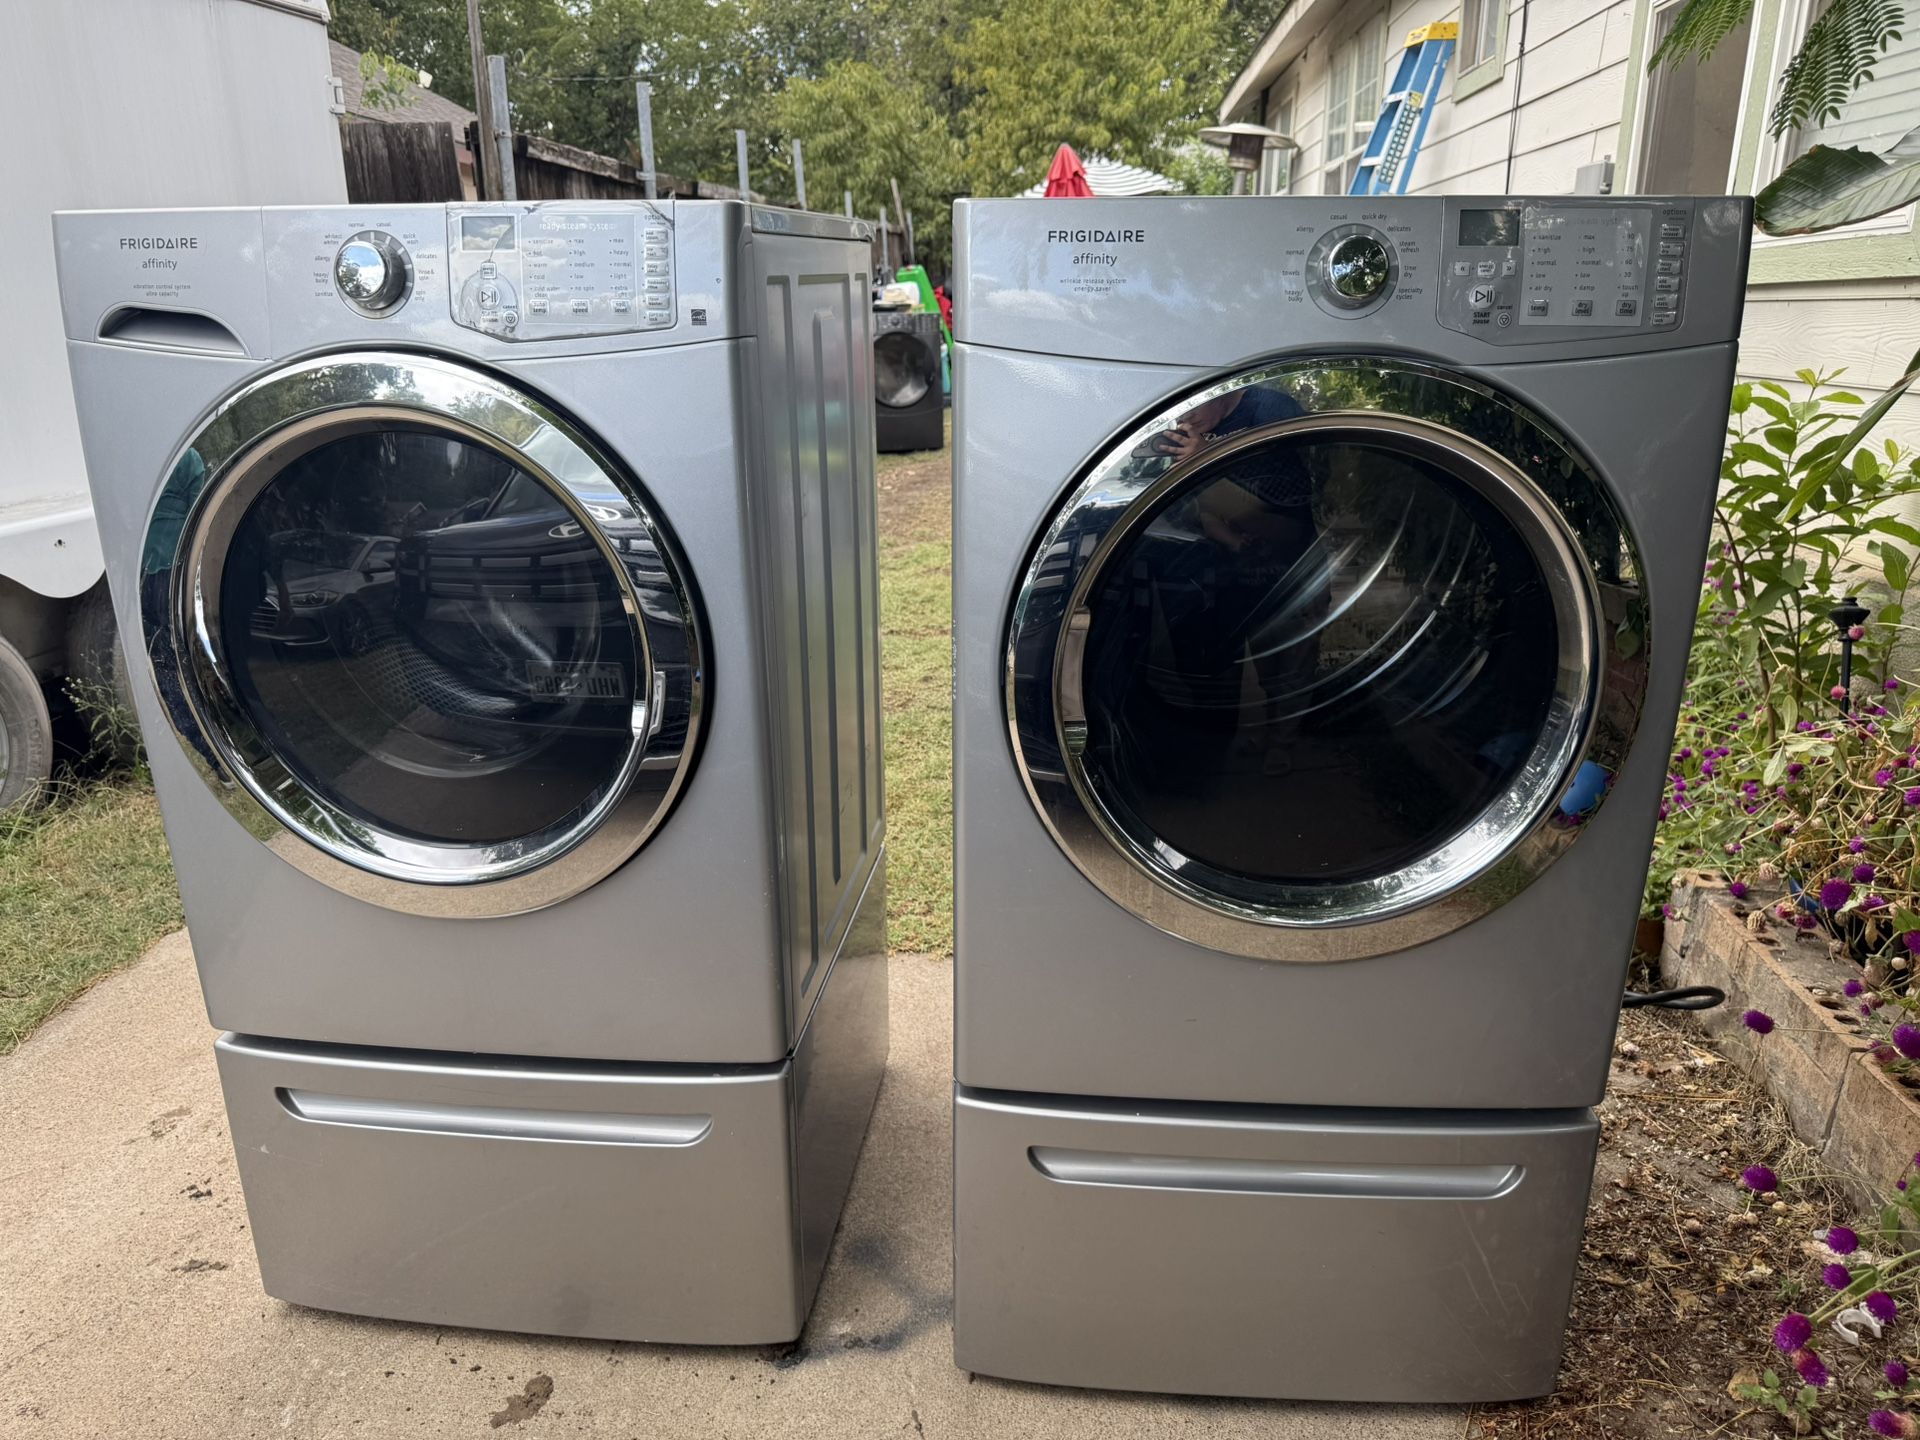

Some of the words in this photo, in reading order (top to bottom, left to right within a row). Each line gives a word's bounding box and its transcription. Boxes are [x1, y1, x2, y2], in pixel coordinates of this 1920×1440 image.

[1361, 213, 1377, 221] quick
[1378, 213, 1388, 221] dry
[1662, 208, 1687, 216] options
[1048, 230, 1145, 243] FRIGIDAIRE
[120, 237, 198, 250] FRIGIDAIRE
[142, 258, 178, 271] affinity
[1072, 252, 1118, 267] affinity
